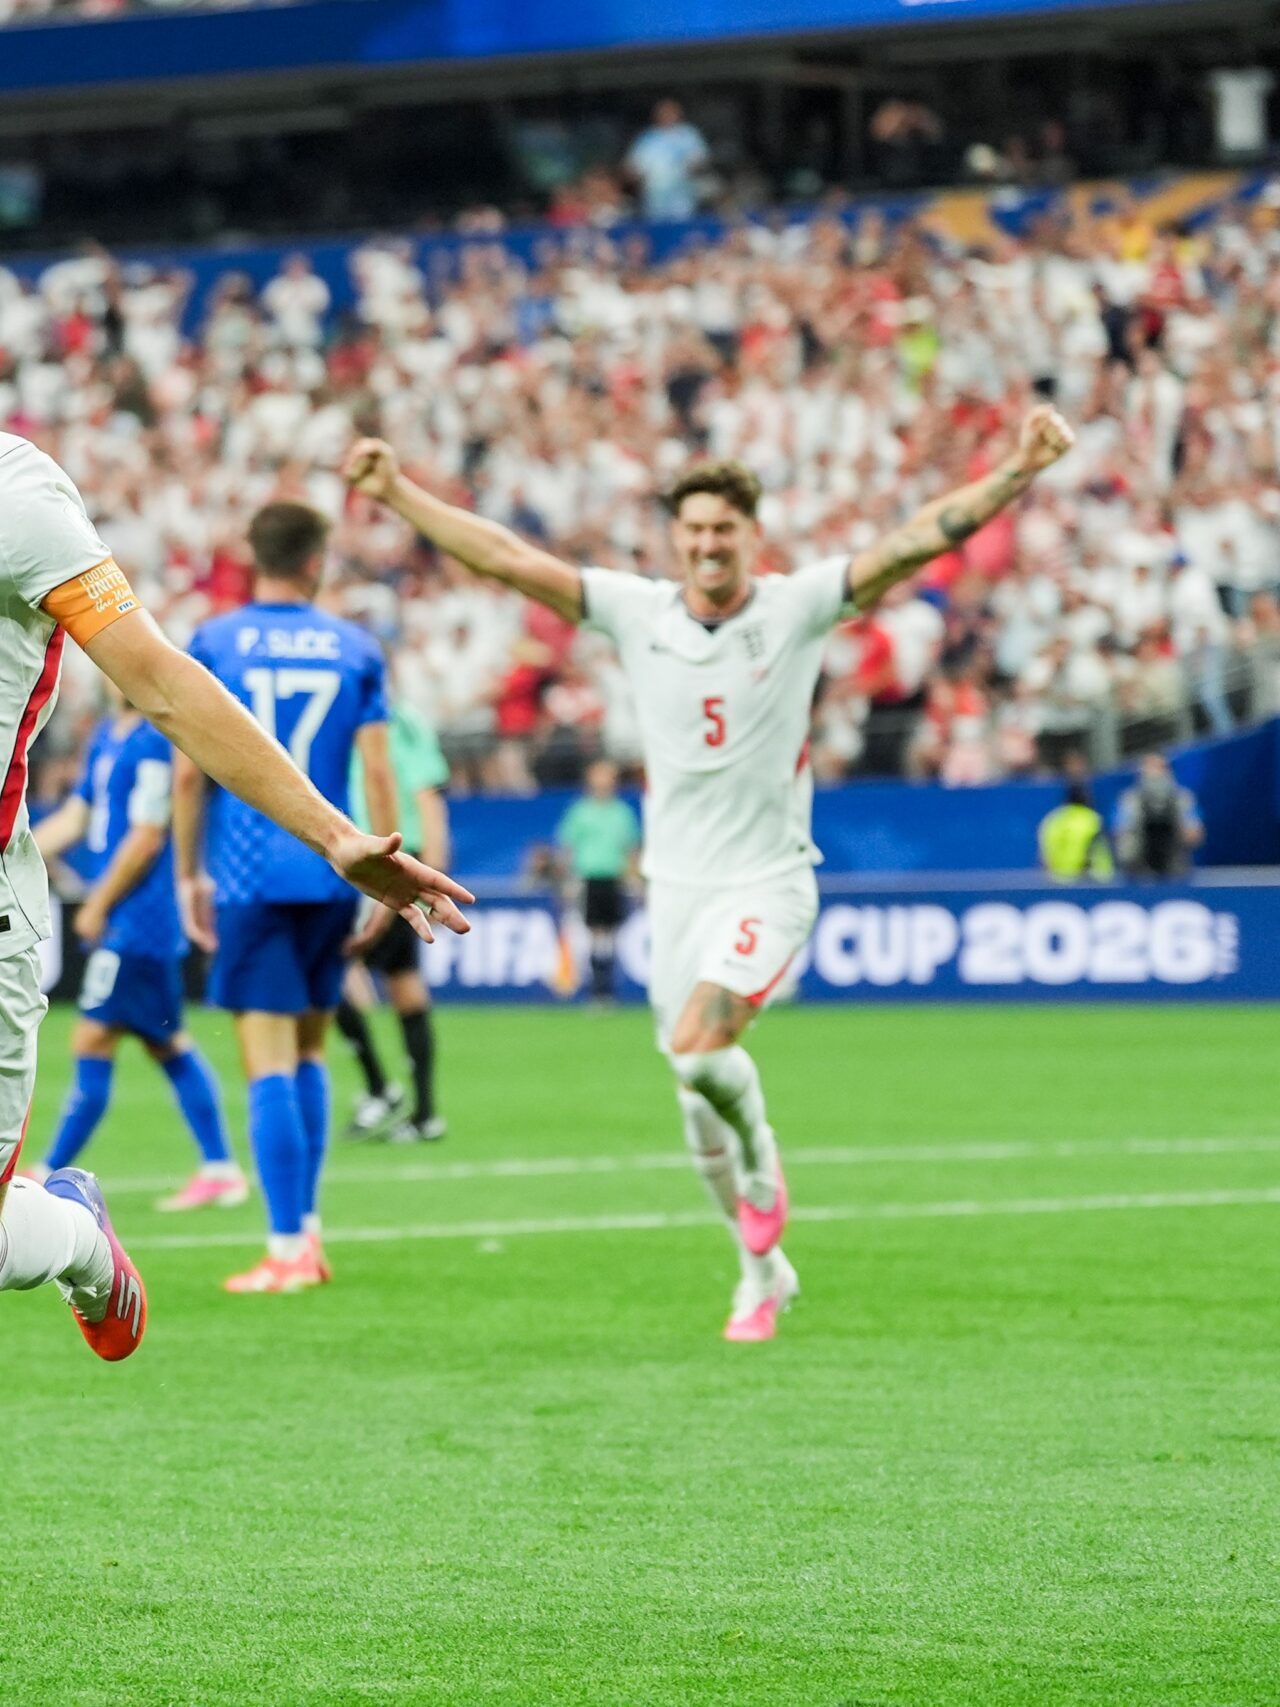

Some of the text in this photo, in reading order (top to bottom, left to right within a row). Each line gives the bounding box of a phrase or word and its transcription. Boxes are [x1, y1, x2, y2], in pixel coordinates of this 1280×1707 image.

[243, 668, 341, 778] 17
[703, 695, 727, 748] 5
[420, 908, 560, 987] FIFA
[816, 904, 959, 986] CUP
[959, 900, 1217, 985] 2026
[735, 917, 762, 955] 5
